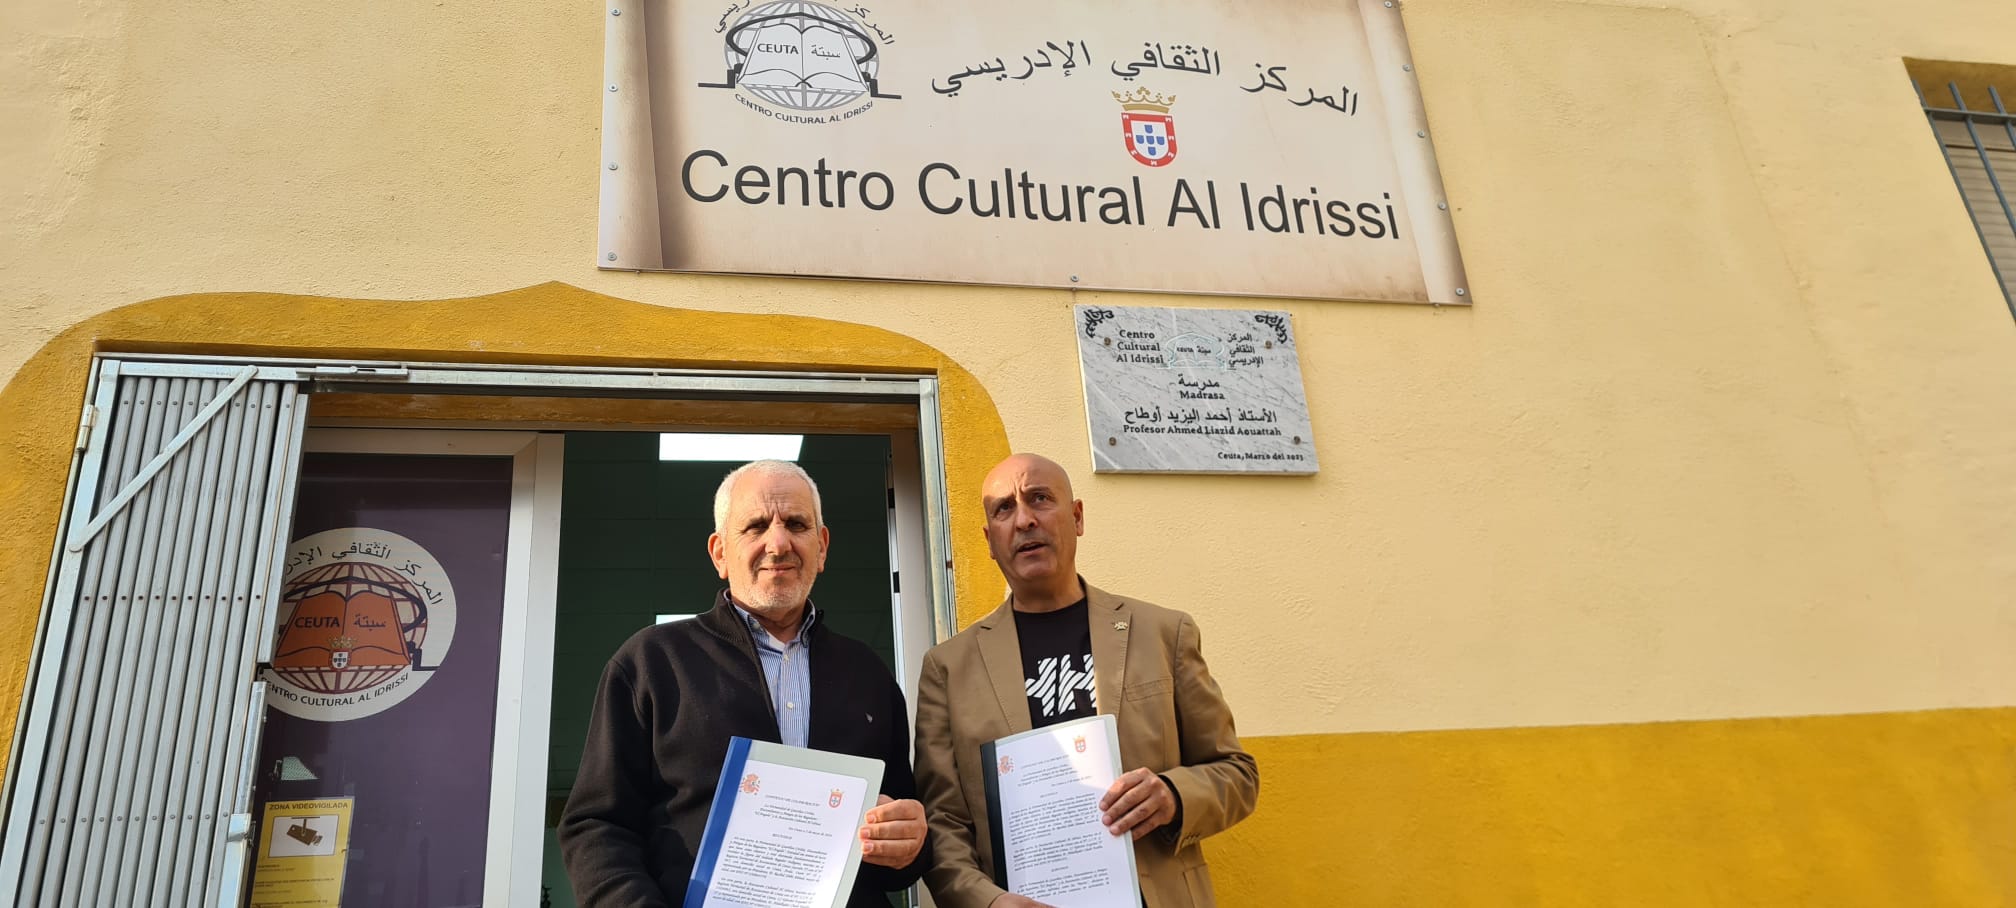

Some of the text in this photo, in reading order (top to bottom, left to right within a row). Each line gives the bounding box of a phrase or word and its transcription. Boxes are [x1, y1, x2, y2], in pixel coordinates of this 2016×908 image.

[757, 43, 799, 55] CEUTA
[811, 45, 841, 60] سبتة
[931, 40, 1358, 117] المركز الثقافي الإدريسي
[735, 94, 873, 124] CENTRO CULTURAL AL IDRISSI
[681, 149, 1400, 240] Centro Cultural Al Idrissi
[1119, 330, 1155, 339] Centro
[1228, 333, 1253, 342] المركز
[1117, 342, 1161, 351] Cultural
[1229, 344, 1255, 357] الثقافي
[1116, 354, 1164, 364] Al Idrissi
[1229, 356, 1264, 368] الإدريسي
[1178, 373, 1220, 390] مدرسة
[1180, 390, 1226, 400] Madrasa
[1124, 406, 1277, 424] الأستاذ أحمد اليزيد أوطاح
[1123, 424, 1282, 436] Profesor Ahmed Liazid Aouattah
[1245, 452, 1271, 460] Marzo
[1272, 452, 1285, 460] del
[394, 560, 443, 604] المركز
[294, 617, 340, 629] CEUTA
[300, 695, 355, 706] CULTURAL
[358, 693, 371, 702] AL
[374, 672, 409, 697] IDRISSI
[292, 802, 348, 810] VIDEOVIGILADA
